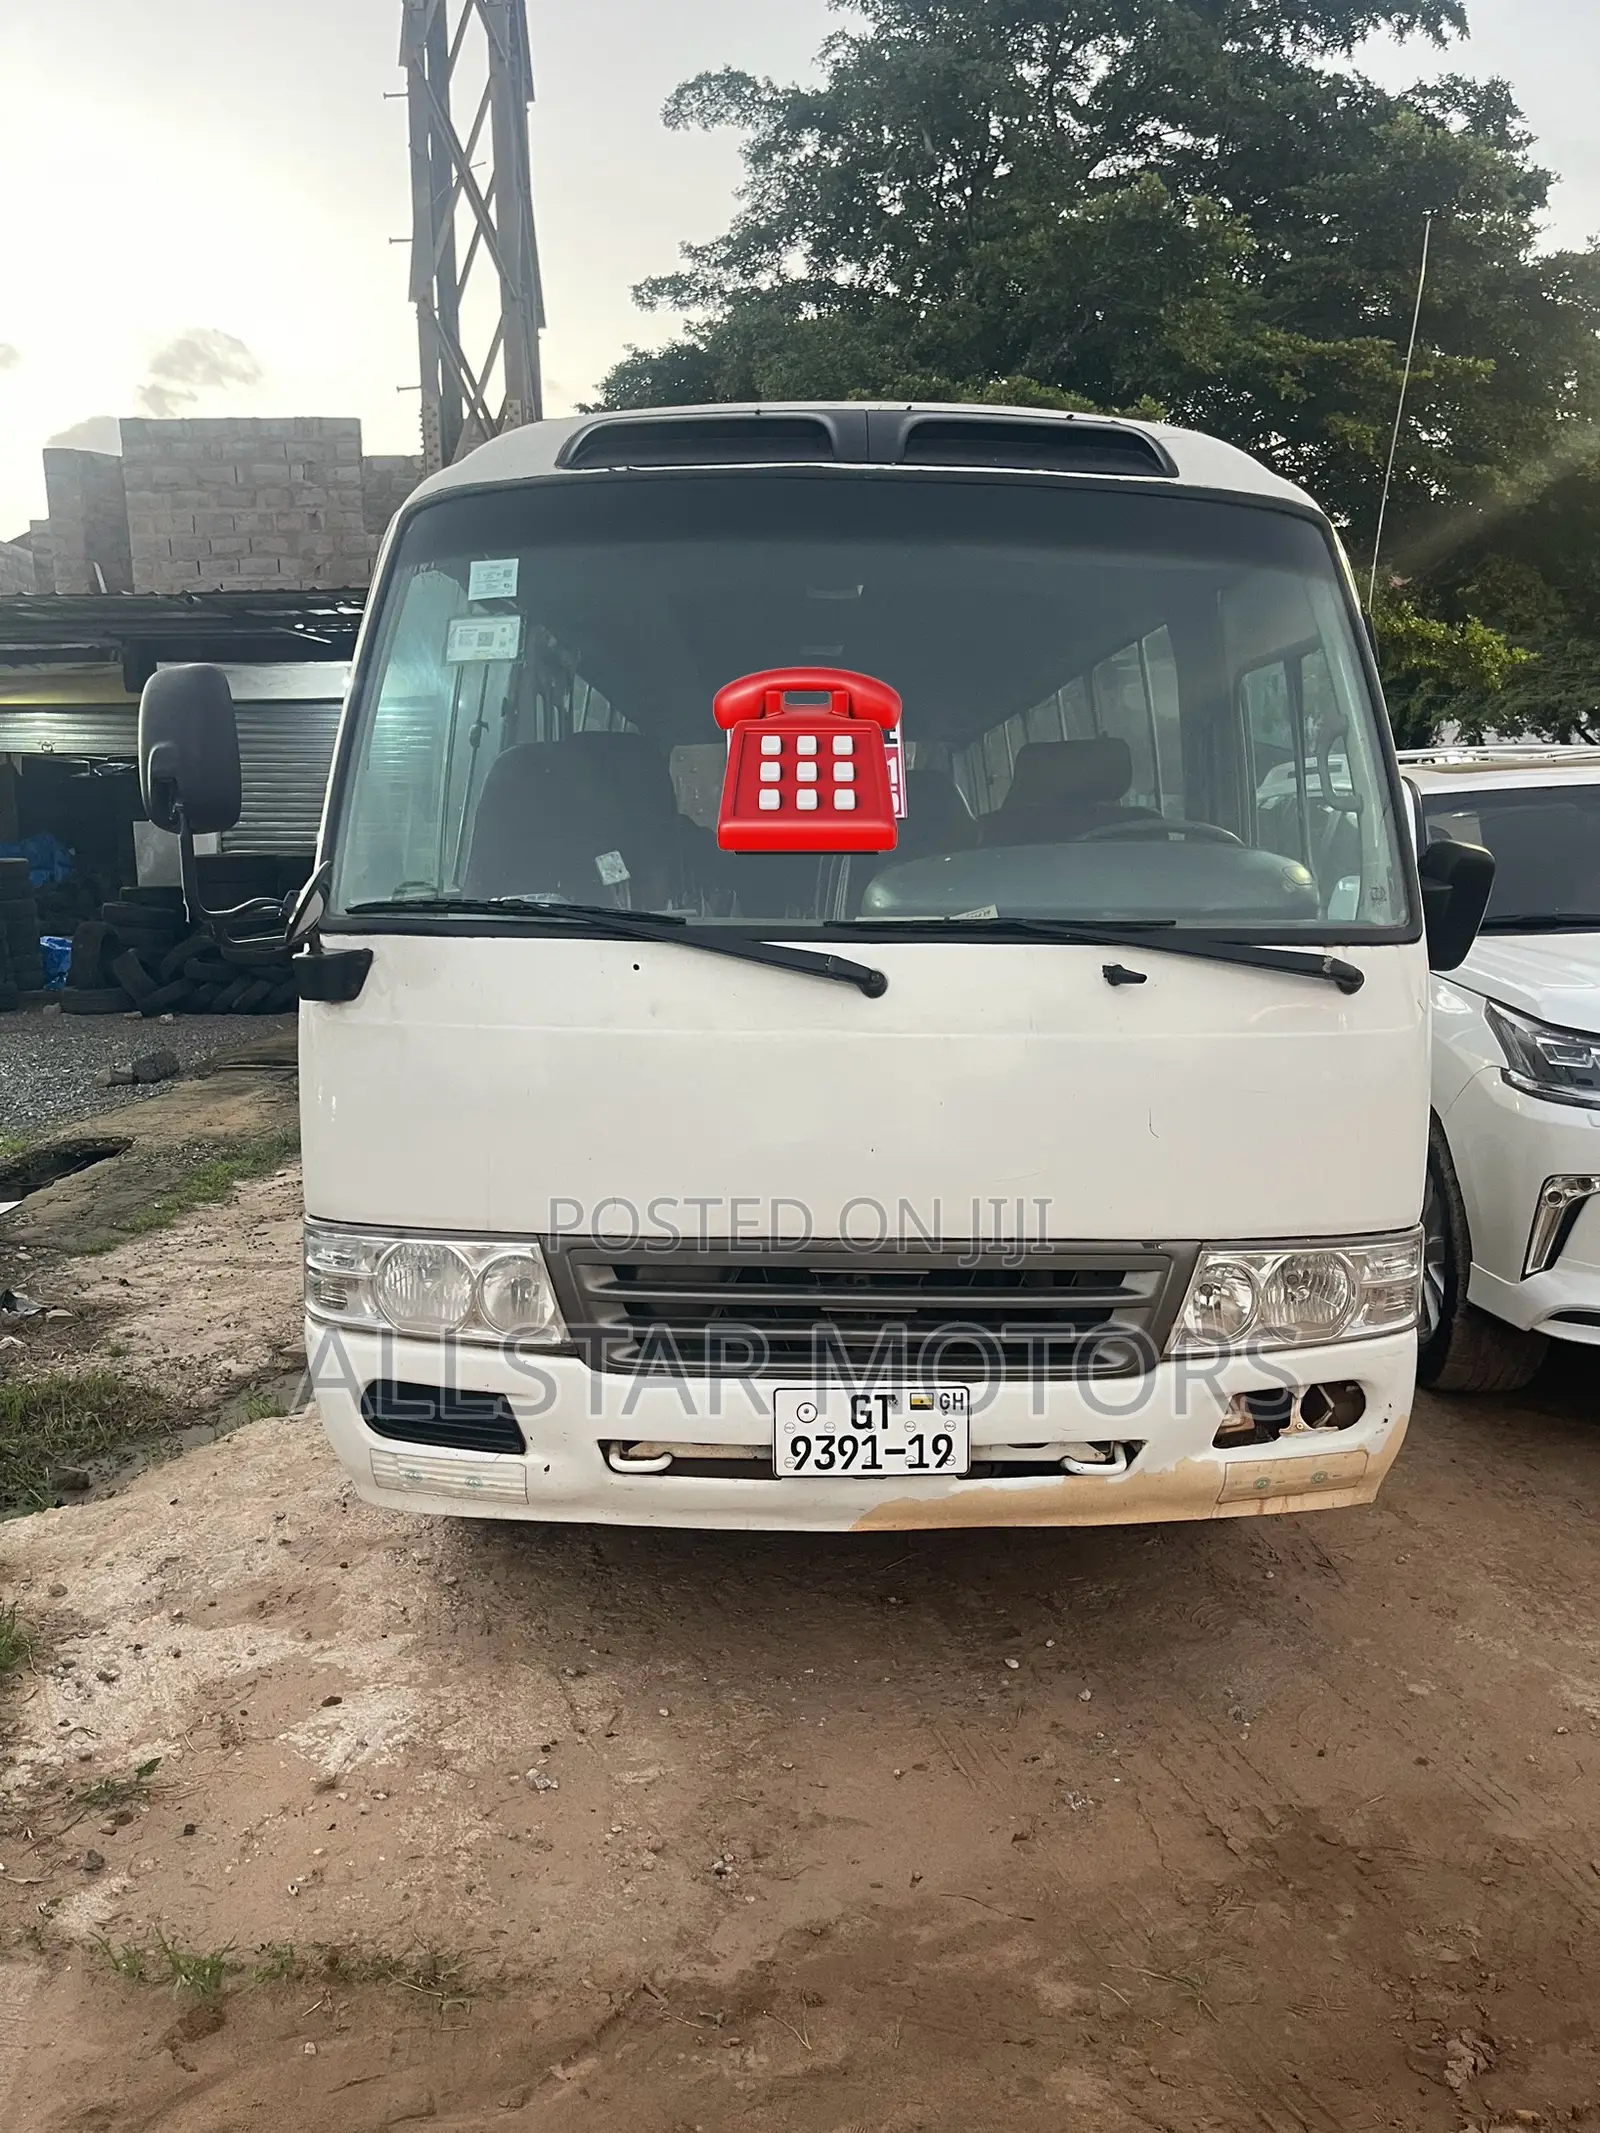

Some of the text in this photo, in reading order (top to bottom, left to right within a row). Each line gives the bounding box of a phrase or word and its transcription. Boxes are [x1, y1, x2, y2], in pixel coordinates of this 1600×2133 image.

[850, 1394, 897, 1430] GT
[939, 1392, 964, 1411] GH
[790, 1433, 953, 1471] 9391-19
